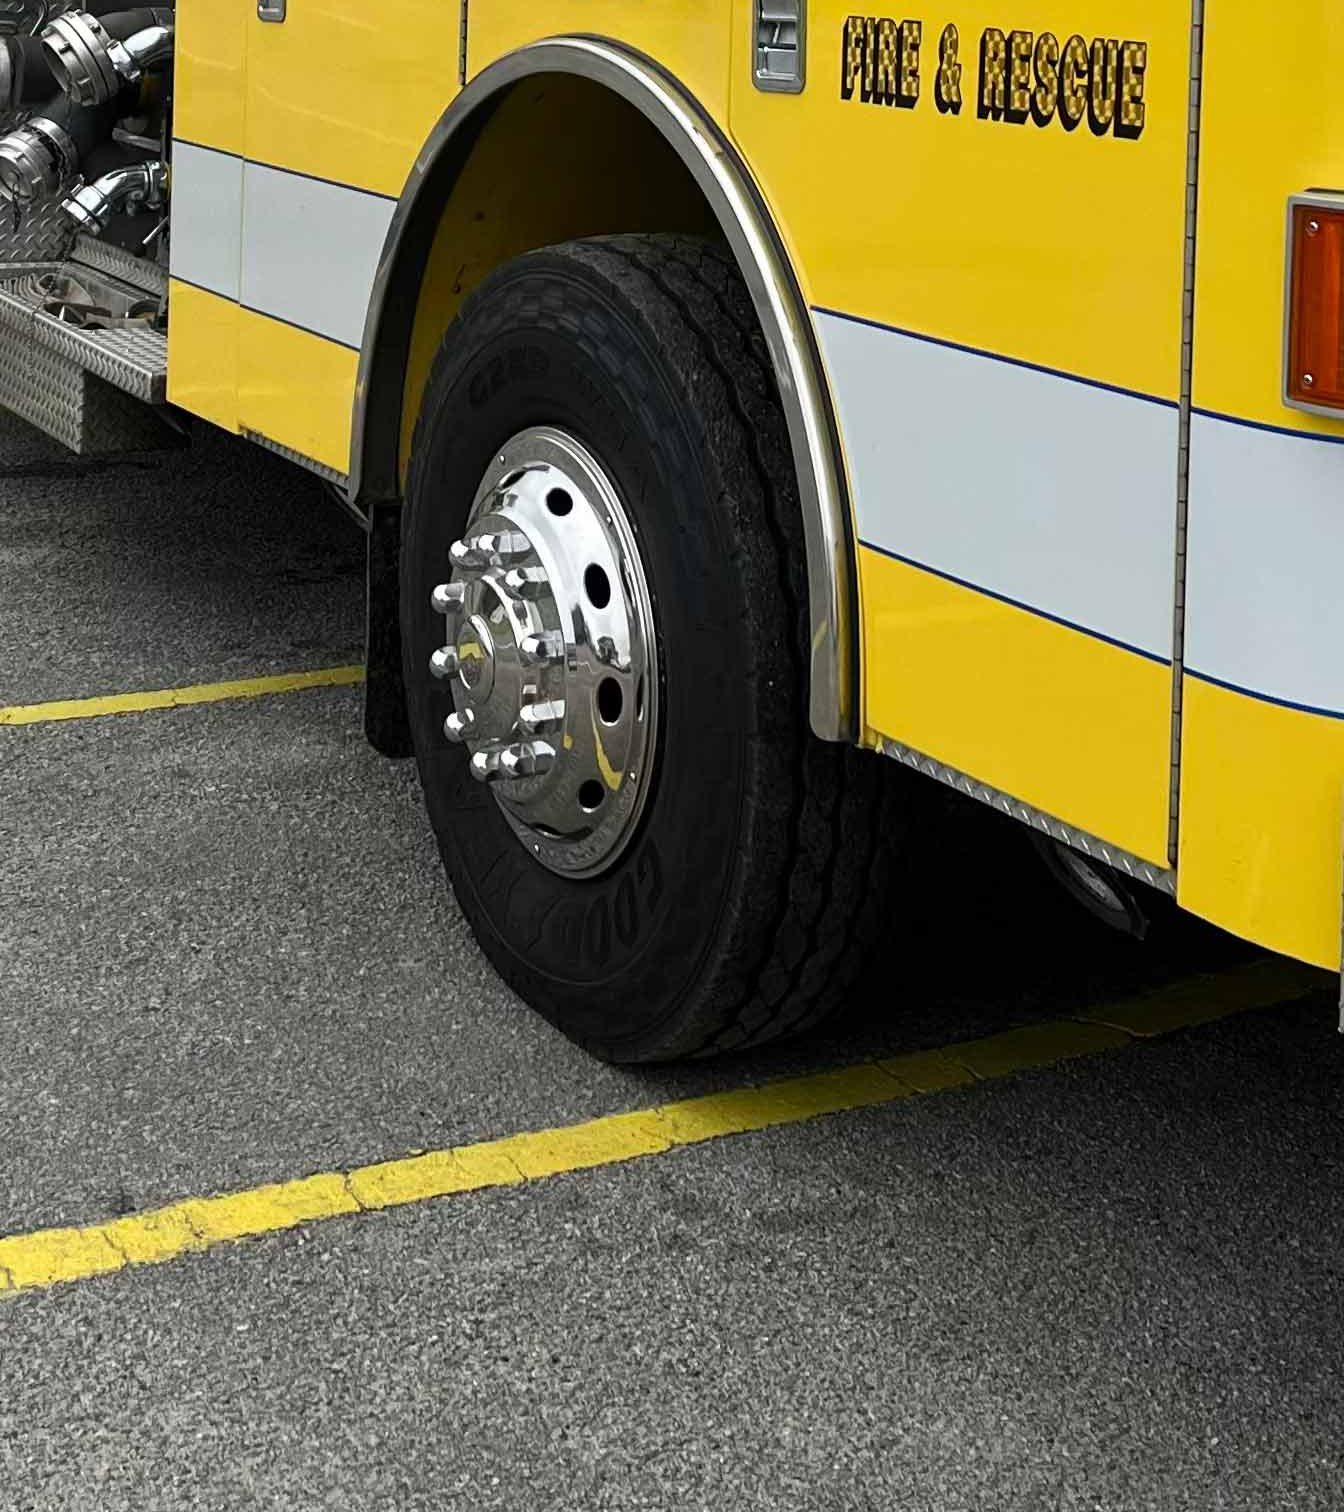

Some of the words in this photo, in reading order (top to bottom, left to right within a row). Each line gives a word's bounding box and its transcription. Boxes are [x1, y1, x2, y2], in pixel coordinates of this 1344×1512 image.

[841, 16, 922, 109] FIRE
[935, 23, 962, 115] &
[977, 27, 1147, 140] RESCUE
